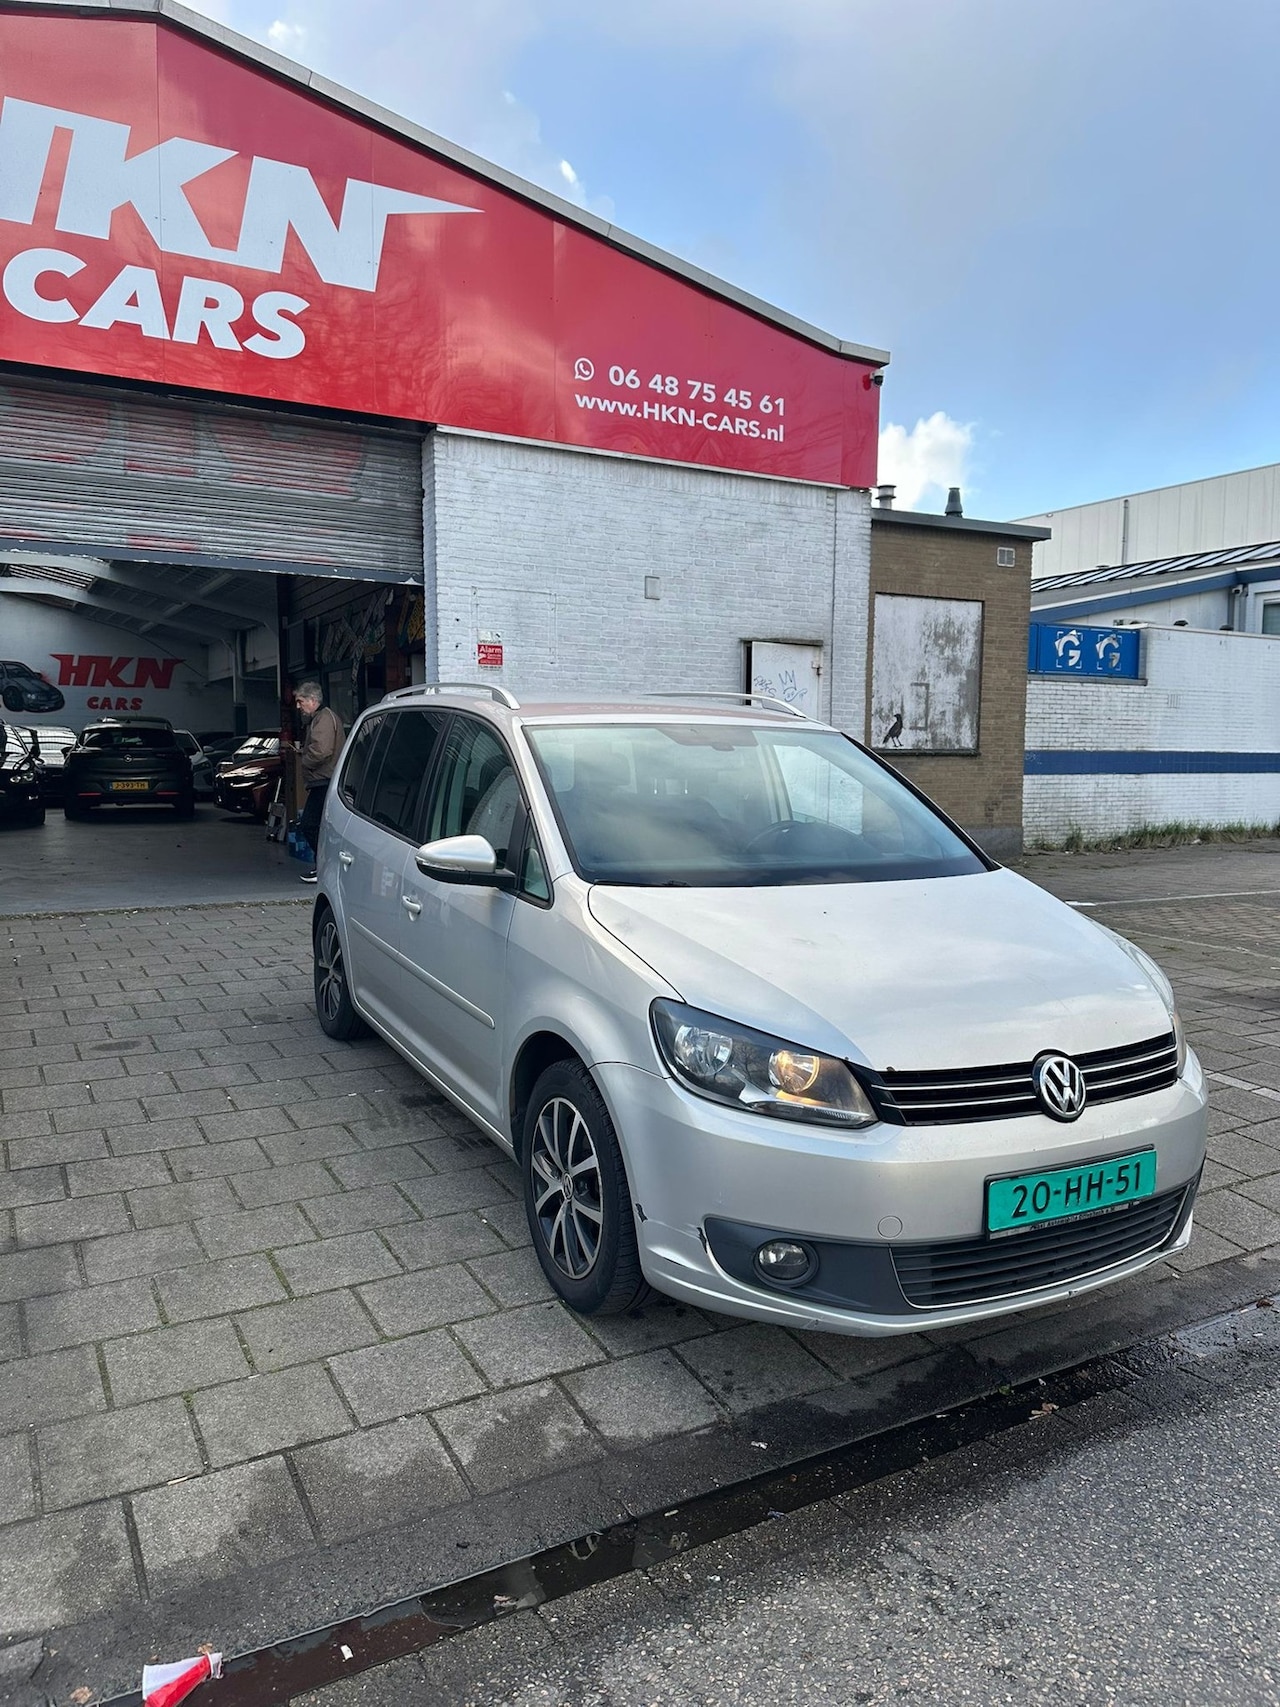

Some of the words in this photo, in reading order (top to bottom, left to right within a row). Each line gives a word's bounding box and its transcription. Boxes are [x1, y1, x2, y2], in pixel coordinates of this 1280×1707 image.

[3, 247, 311, 360] CARS
[608, 365, 641, 389] 06
[648, 373, 679, 396] 48
[687, 379, 717, 403] 75
[723, 388, 753, 410] 45
[759, 396, 785, 417] 61
[574, 393, 785, 443] www.HKN-CARS.nl
[49, 653, 187, 689] HKN
[479, 645, 502, 653] Alarm
[87, 696, 143, 711] CARS
[1011, 1161, 1140, 1219] 20-HH-51
